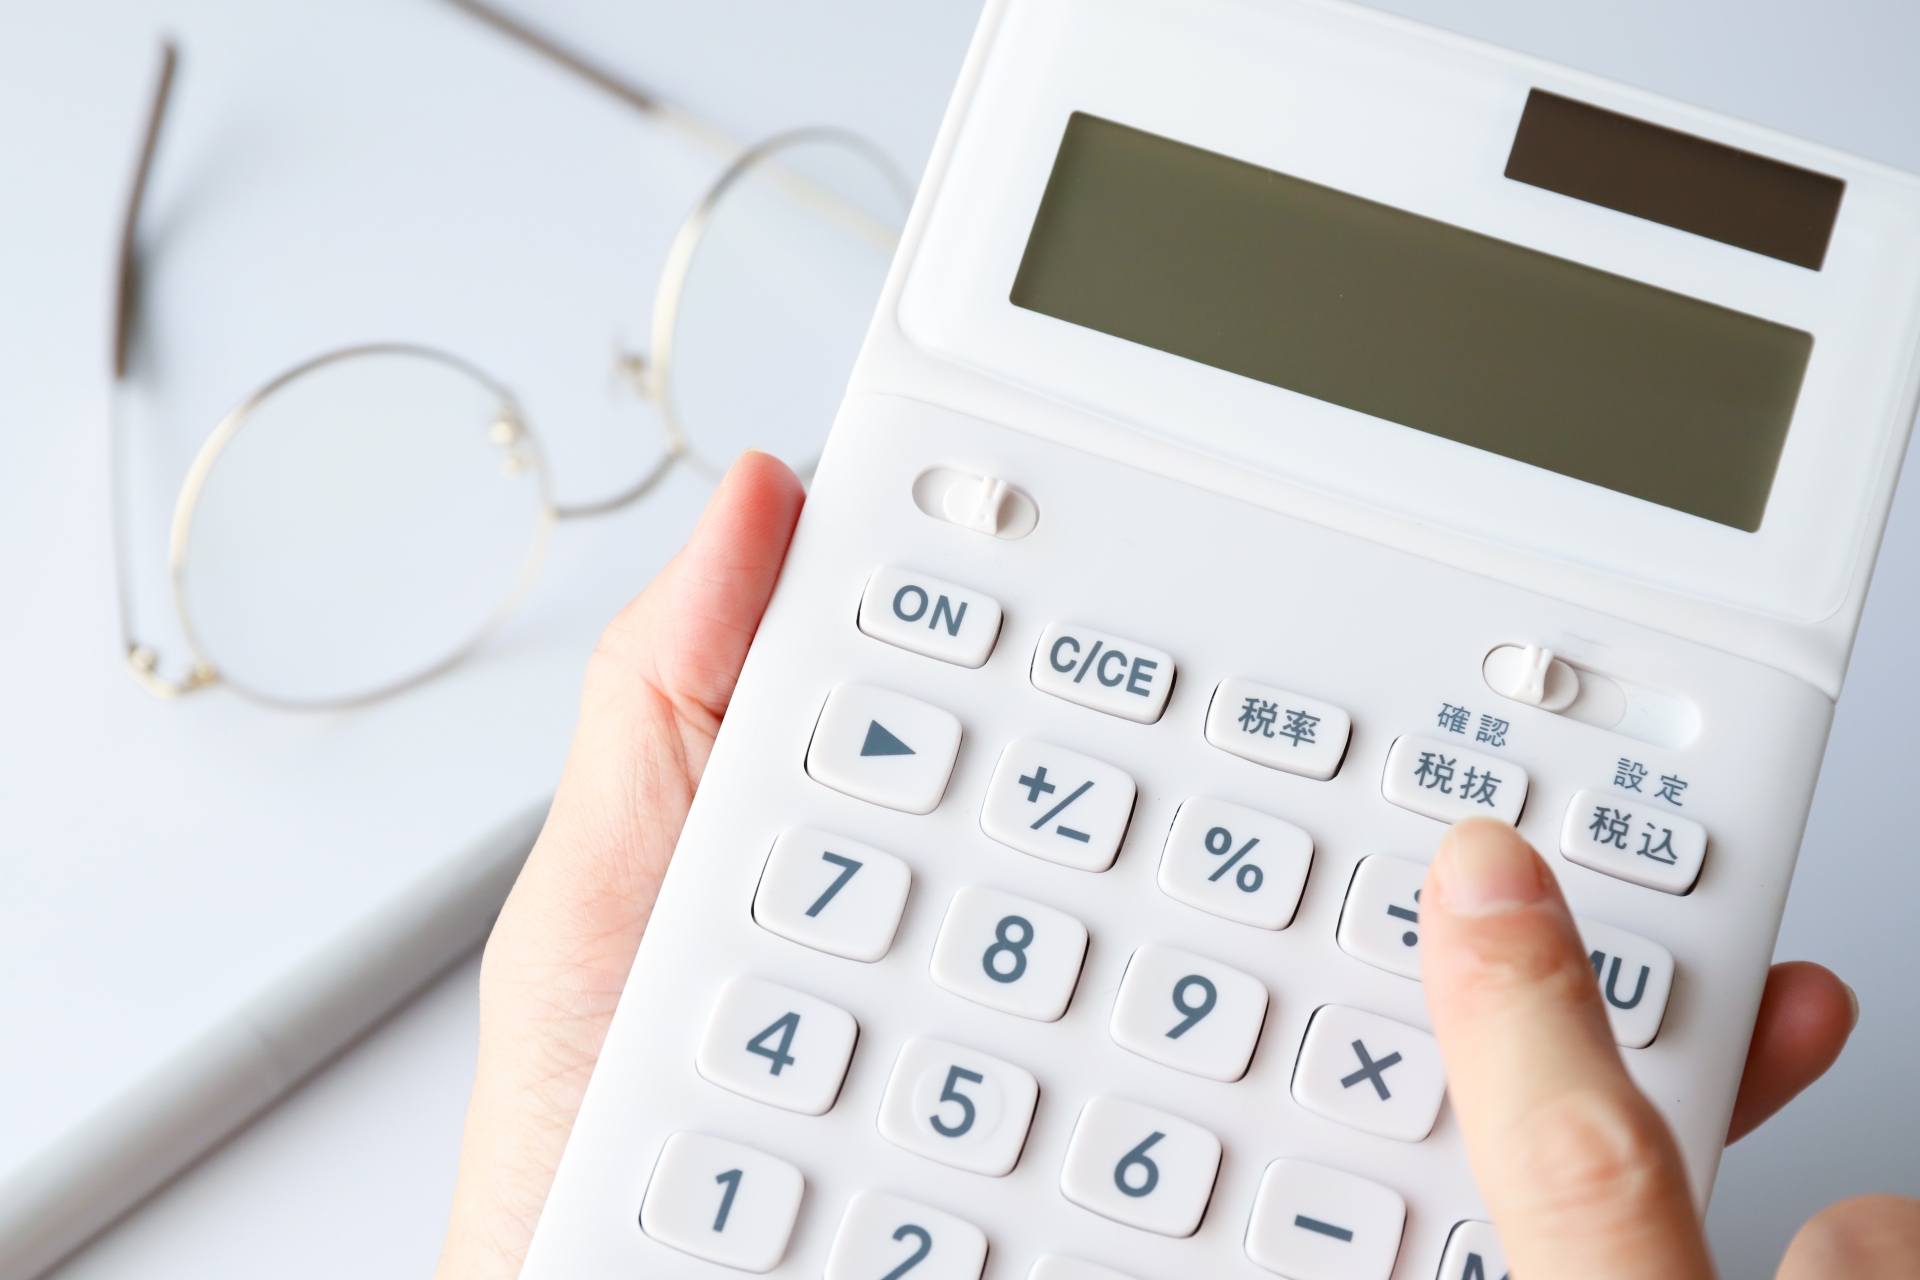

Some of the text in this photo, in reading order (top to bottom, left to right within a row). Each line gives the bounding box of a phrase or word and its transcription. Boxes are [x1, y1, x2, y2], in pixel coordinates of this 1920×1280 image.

[892, 584, 968, 637] ON
[1049, 635, 1158, 698] C/CE
[1237, 697, 1321, 748] 税率
[1437, 702, 1510, 747] 確認
[1413, 751, 1502, 808] 税抜
[1613, 758, 1689, 807] 設定
[1204, 826, 1264, 893] %
[1588, 806, 1680, 866] 税込
[805, 851, 864, 918] 7
[982, 915, 1034, 984] 8
[1588, 949, 1651, 1011] U
[1165, 974, 1218, 1040] 9
[746, 1011, 801, 1076] 4
[929, 1065, 984, 1138] 5
[1113, 1131, 1166, 1198] 6
[712, 1168, 743, 1233] 1
[880, 1224, 933, 1280] 2
